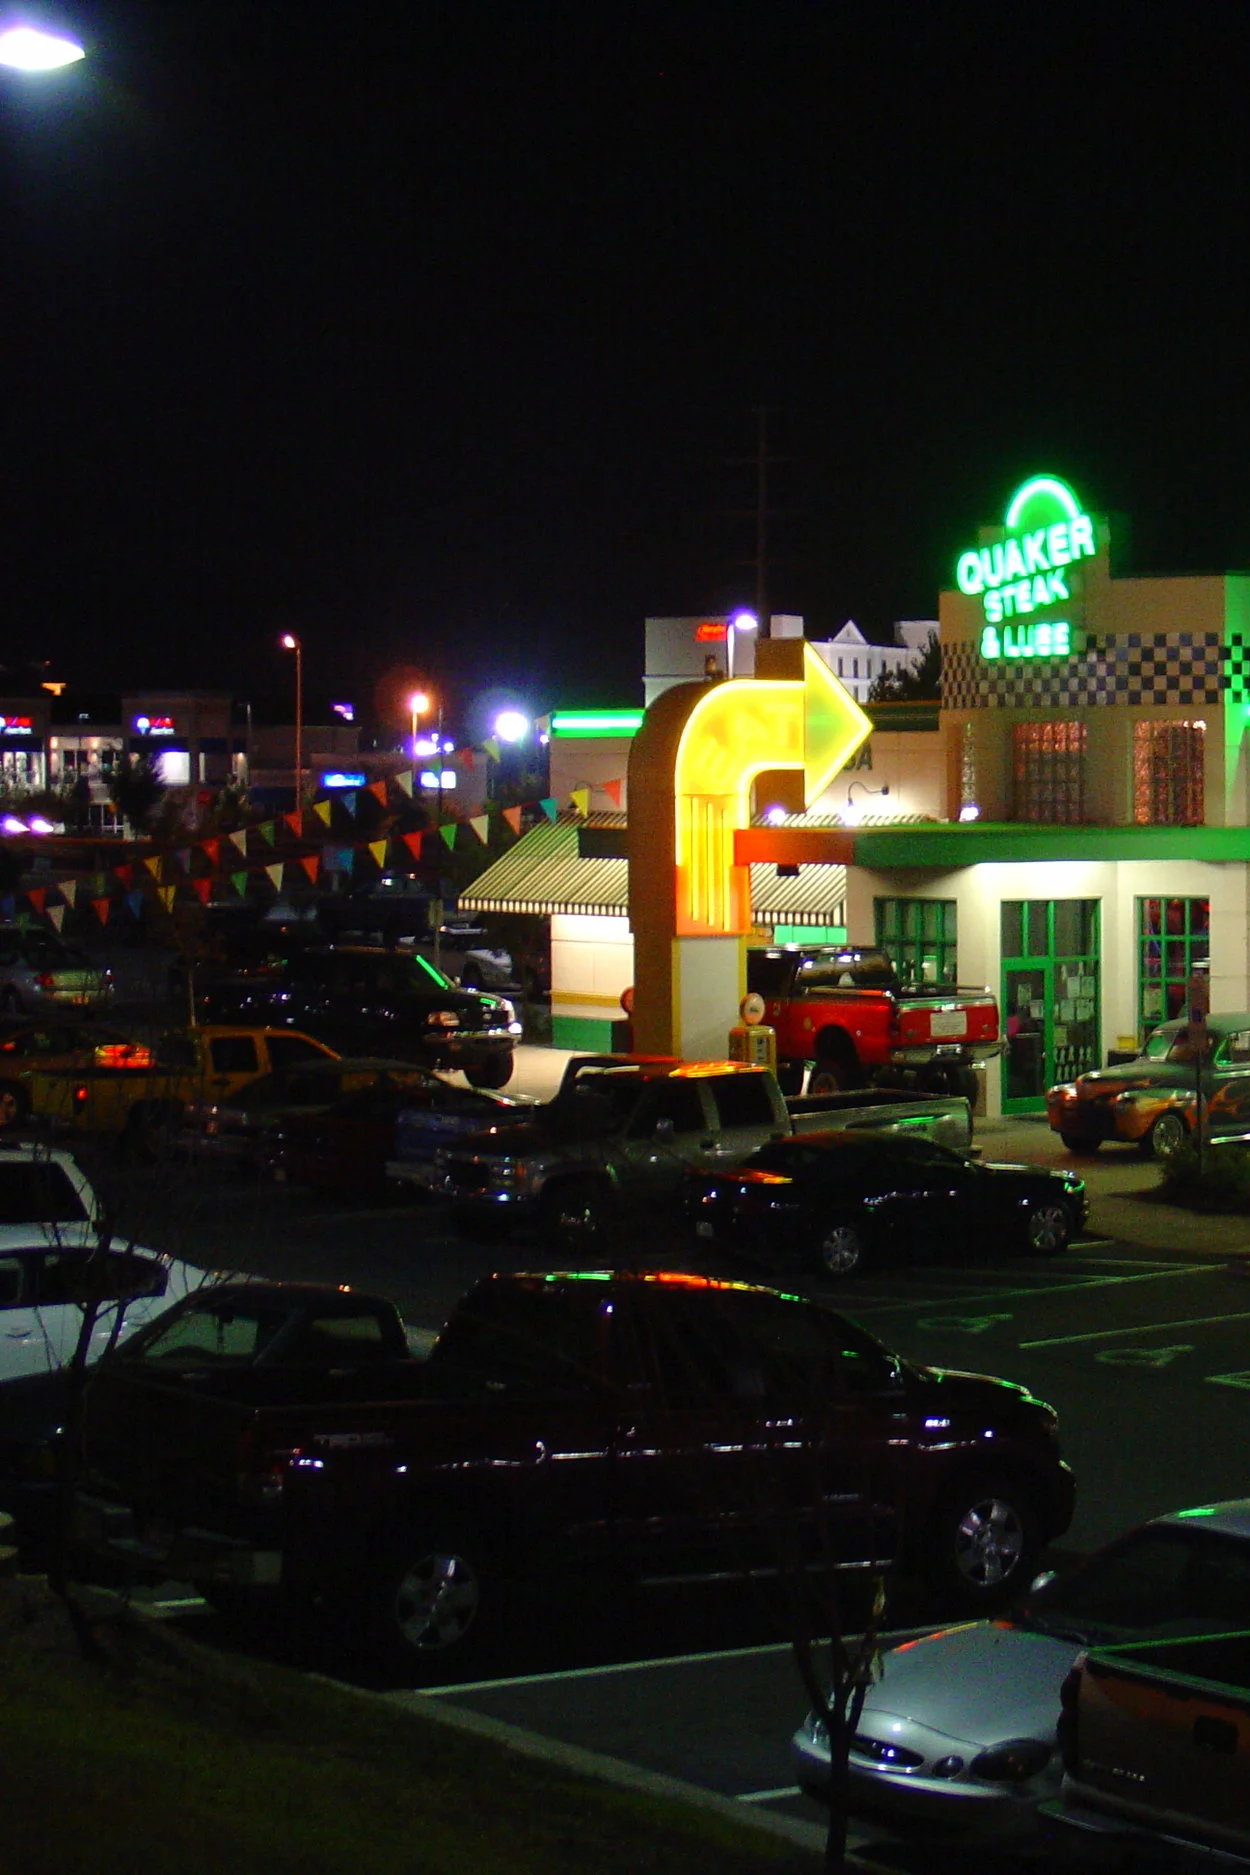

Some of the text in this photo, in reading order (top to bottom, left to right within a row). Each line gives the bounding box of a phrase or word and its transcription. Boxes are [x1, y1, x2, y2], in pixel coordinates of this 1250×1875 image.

[956, 514, 1097, 595] QUAKER
[984, 569, 1069, 623] STEAK
[980, 623, 1070, 659] & LUBE
